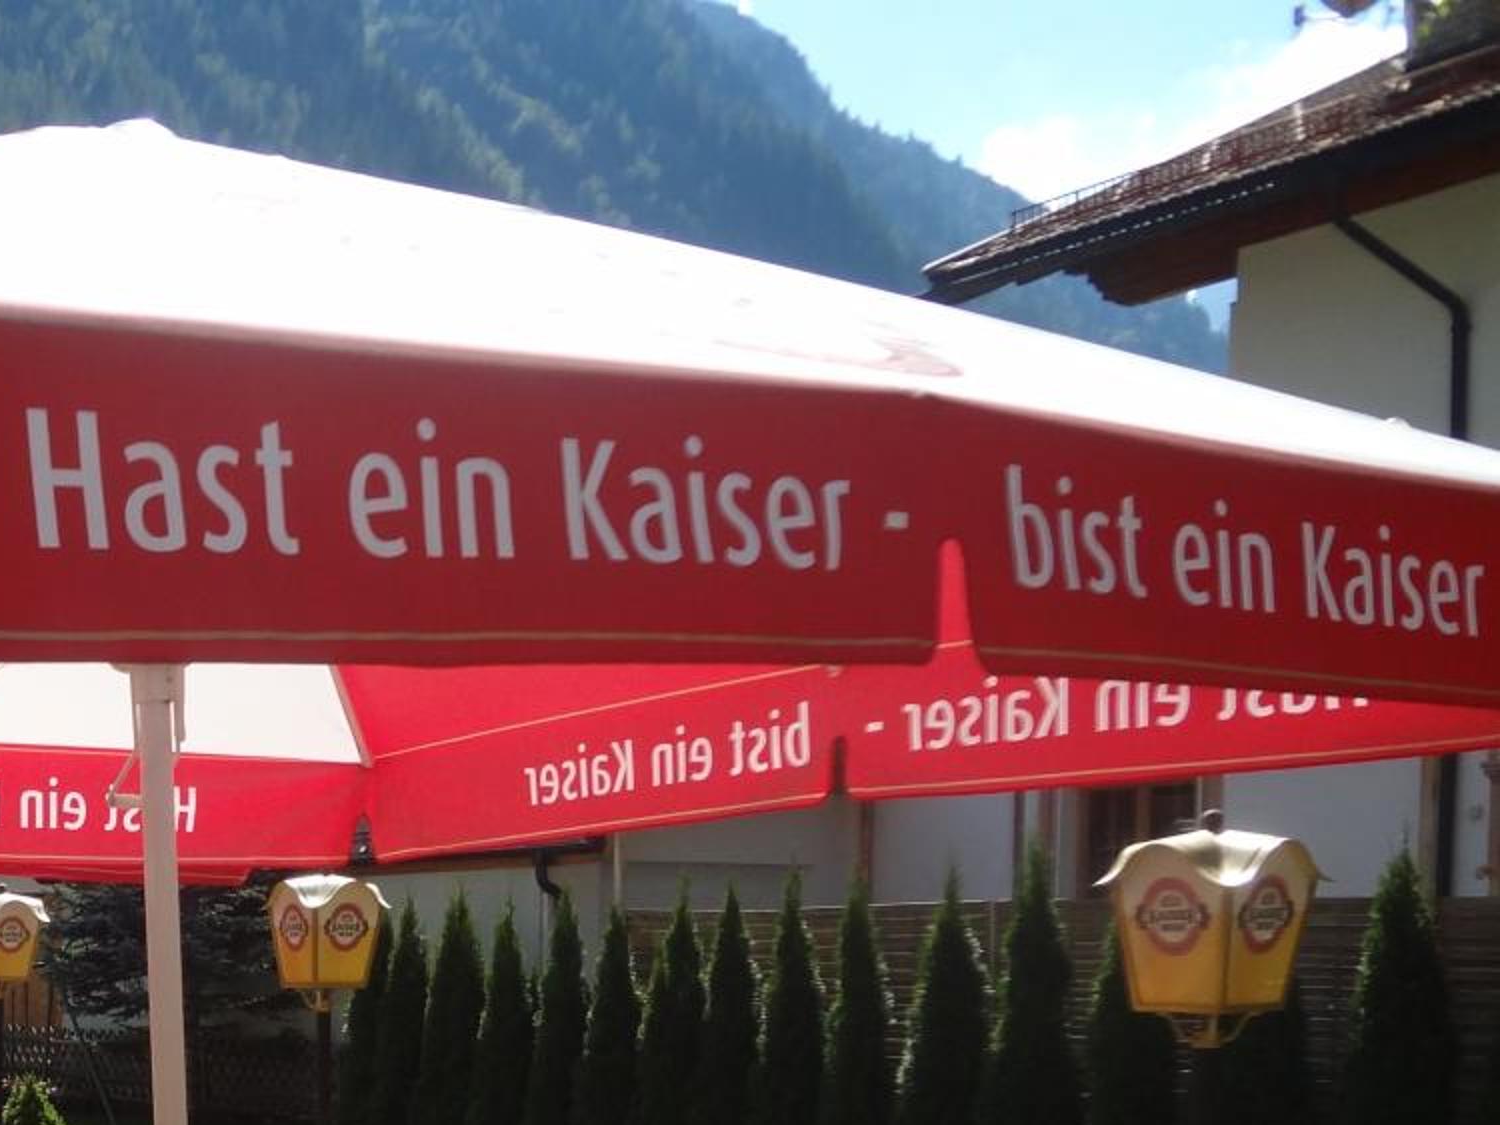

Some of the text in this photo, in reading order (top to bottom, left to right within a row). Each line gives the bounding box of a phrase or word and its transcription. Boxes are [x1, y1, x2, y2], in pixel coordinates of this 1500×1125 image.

[26, 407, 300, 556] Hast
[348, 417, 515, 559] ein
[561, 435, 850, 570] Kaiser
[1006, 463, 1148, 599] bist
[1172, 499, 1276, 614] ein
[1301, 521, 1485, 638] Kaiser
